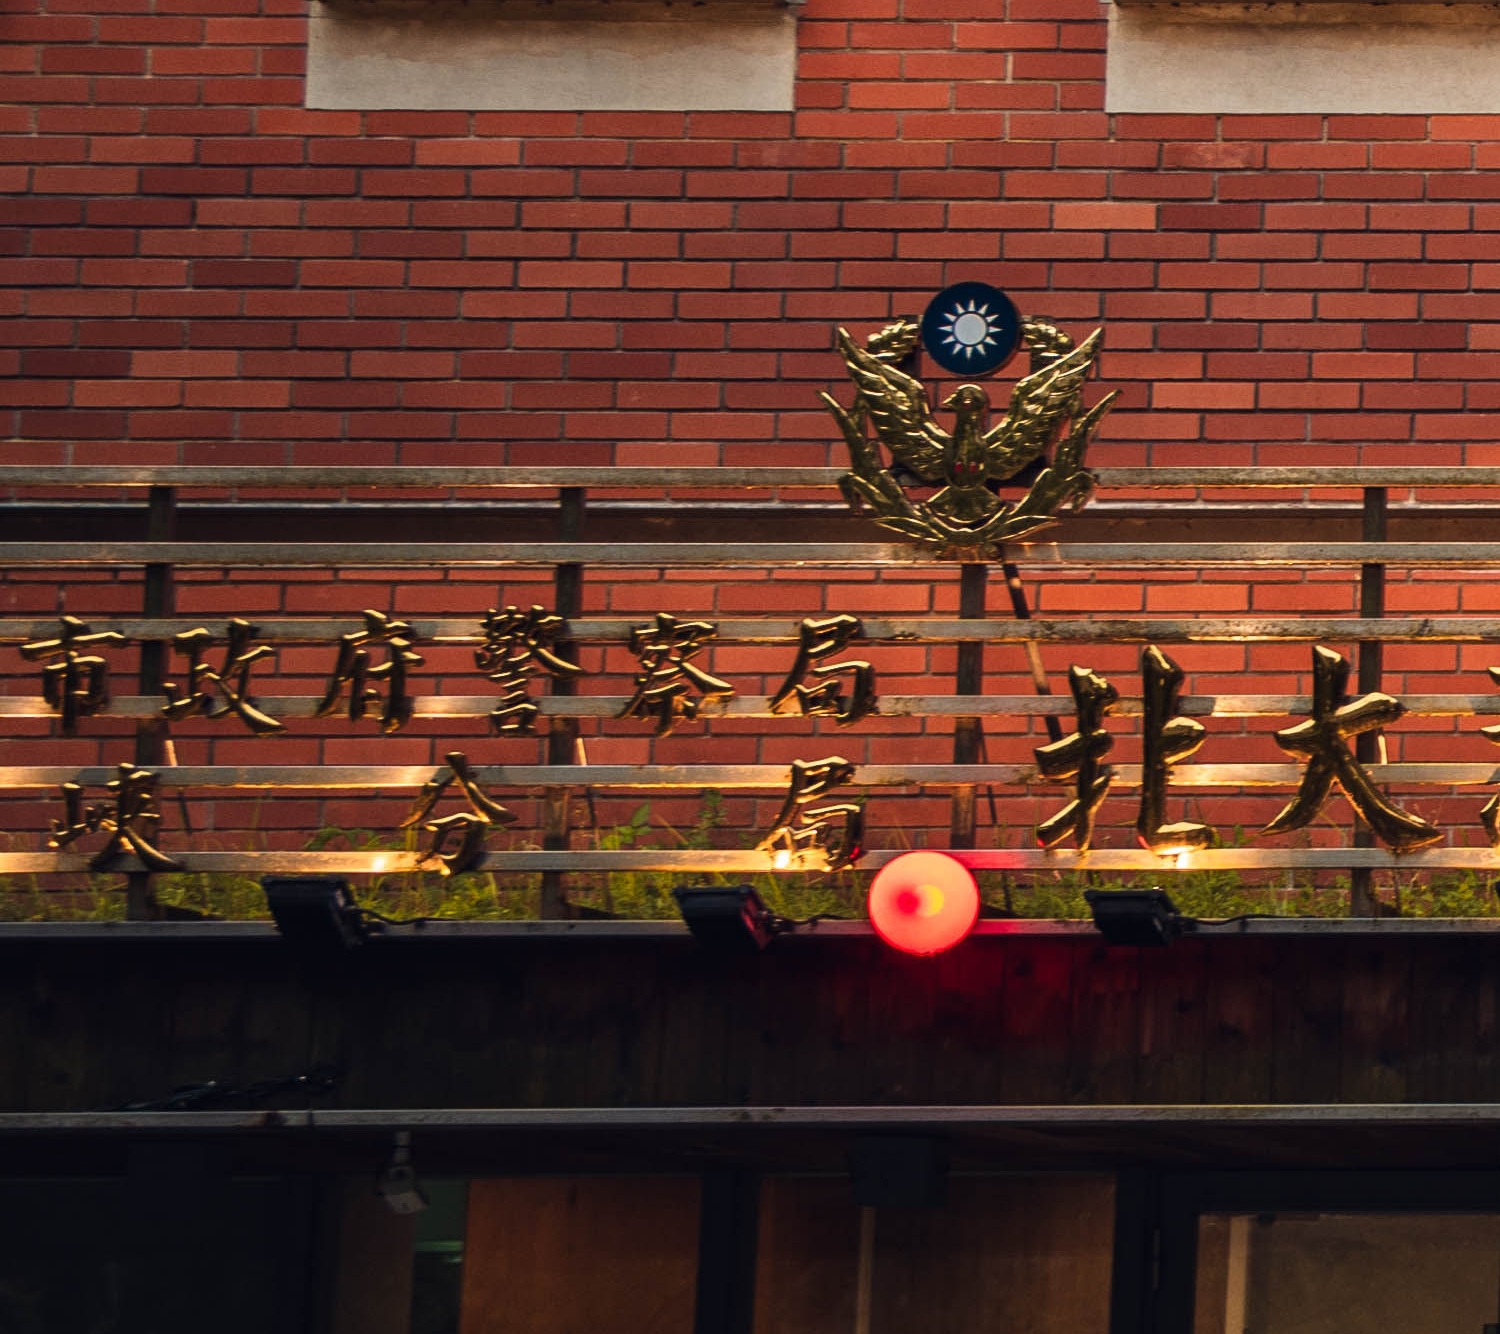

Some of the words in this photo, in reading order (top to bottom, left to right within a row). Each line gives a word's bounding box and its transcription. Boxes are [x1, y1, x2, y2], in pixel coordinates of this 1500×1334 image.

[19, 604, 878, 737] 市政府警察局
